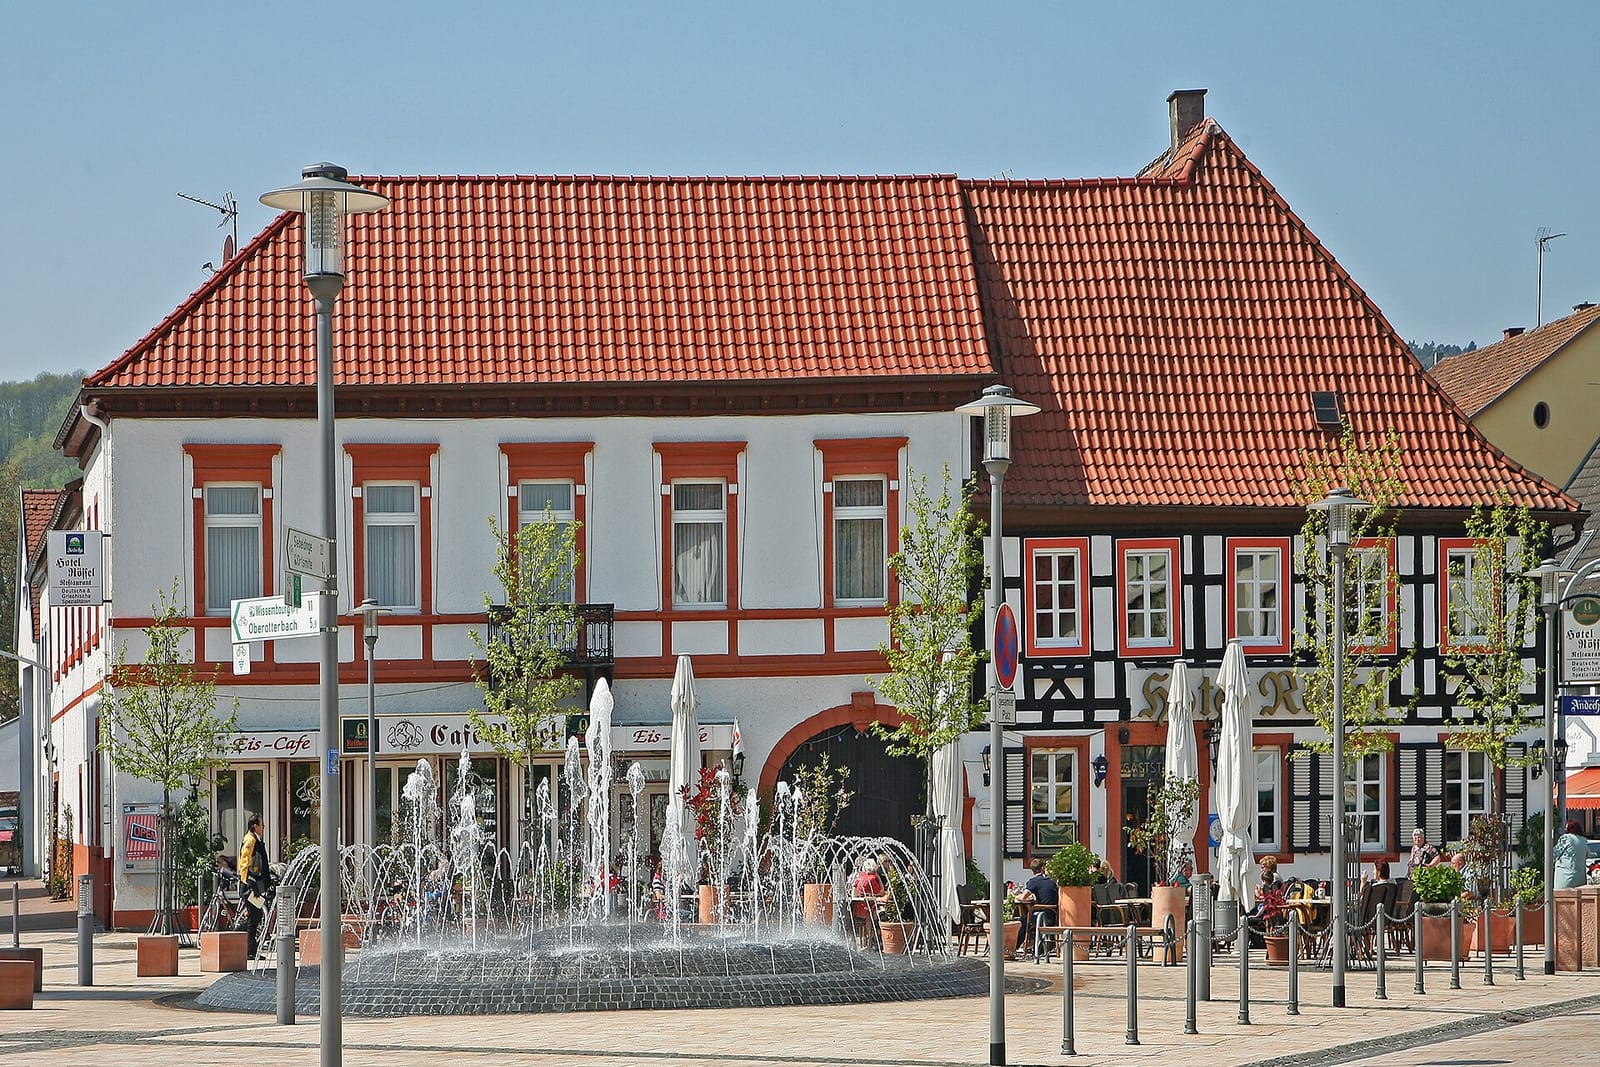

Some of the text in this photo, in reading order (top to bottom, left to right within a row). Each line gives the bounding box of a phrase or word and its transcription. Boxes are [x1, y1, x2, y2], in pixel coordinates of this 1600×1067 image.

[56, 558, 81, 568] Hotel
[248, 619, 298, 634] Oberotterbach
[1566, 629, 1593, 640] Hotel
[133, 827, 157, 840] OPEN
